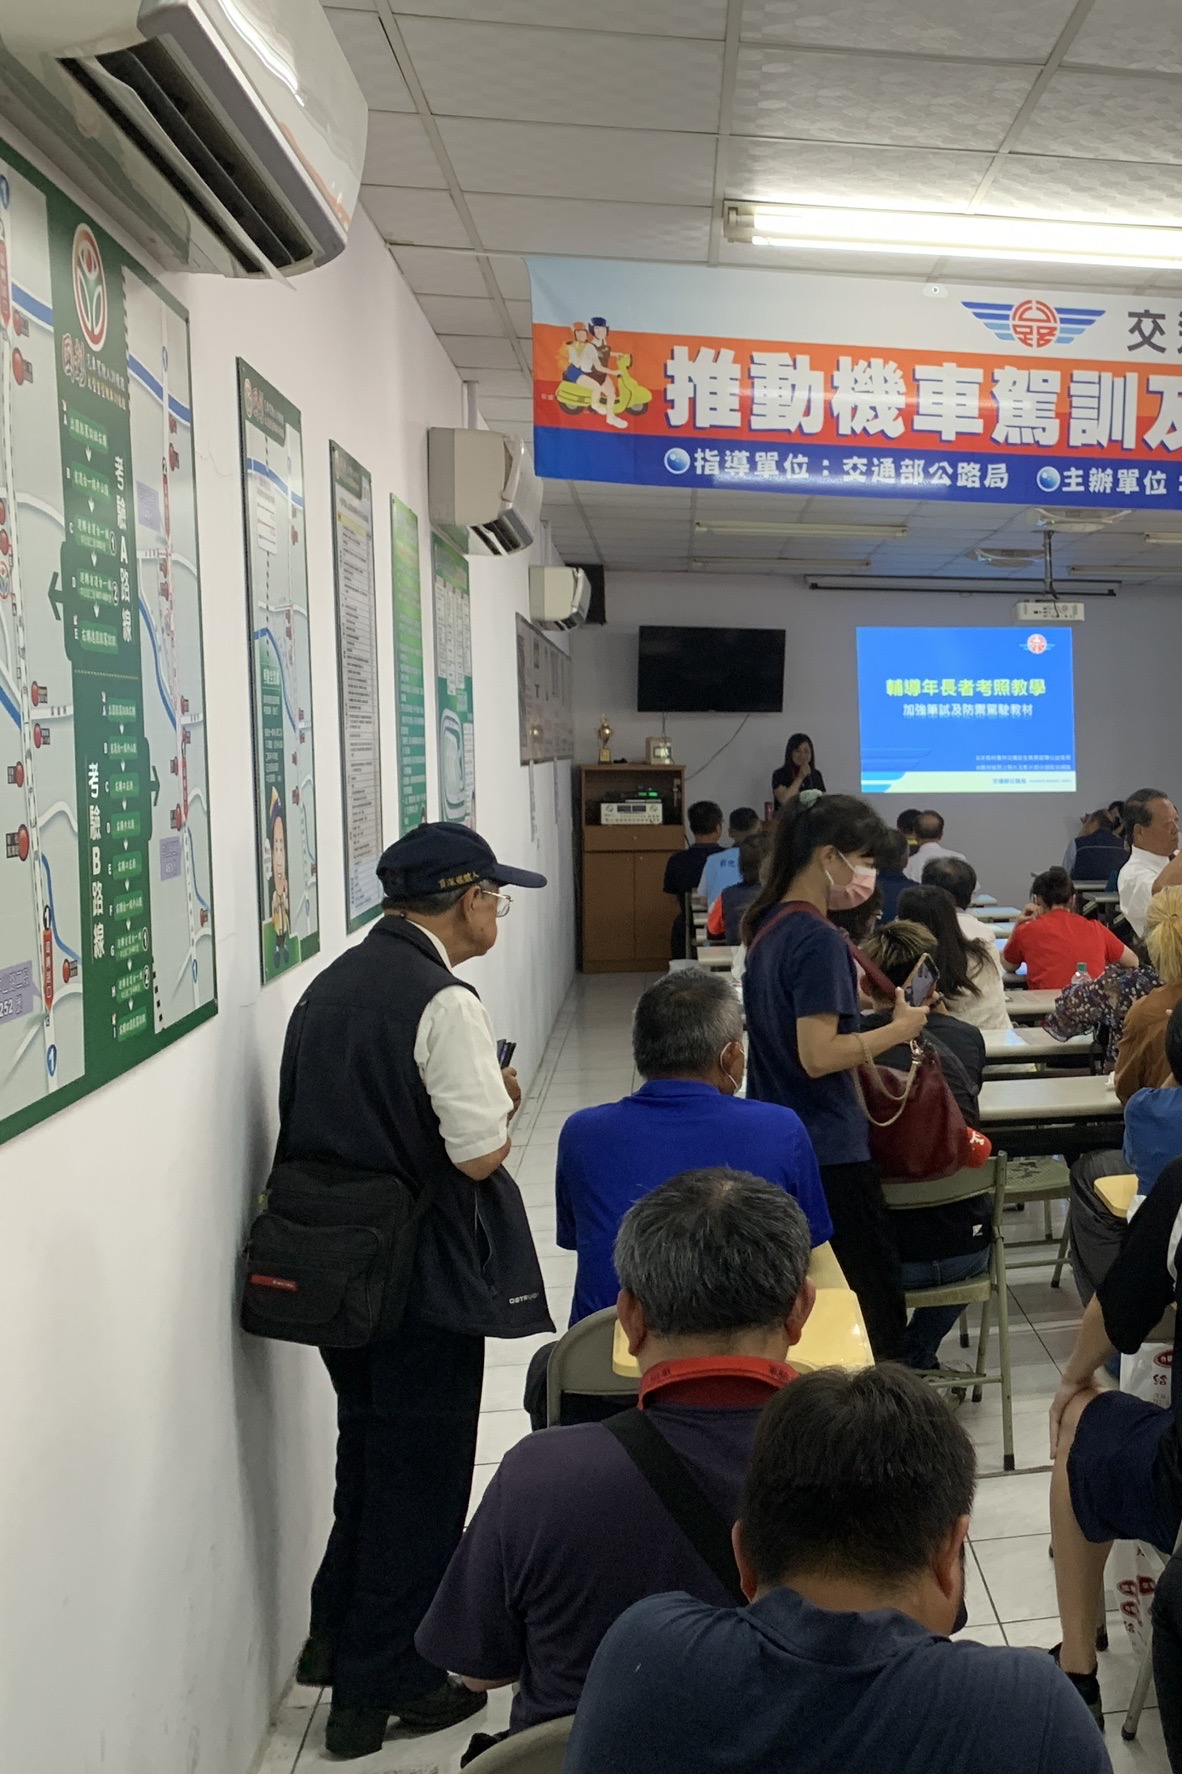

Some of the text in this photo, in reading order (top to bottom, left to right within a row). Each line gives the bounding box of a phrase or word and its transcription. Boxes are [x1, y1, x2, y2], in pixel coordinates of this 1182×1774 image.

[886, 678, 1046, 698] 輔導年長者考照教學
